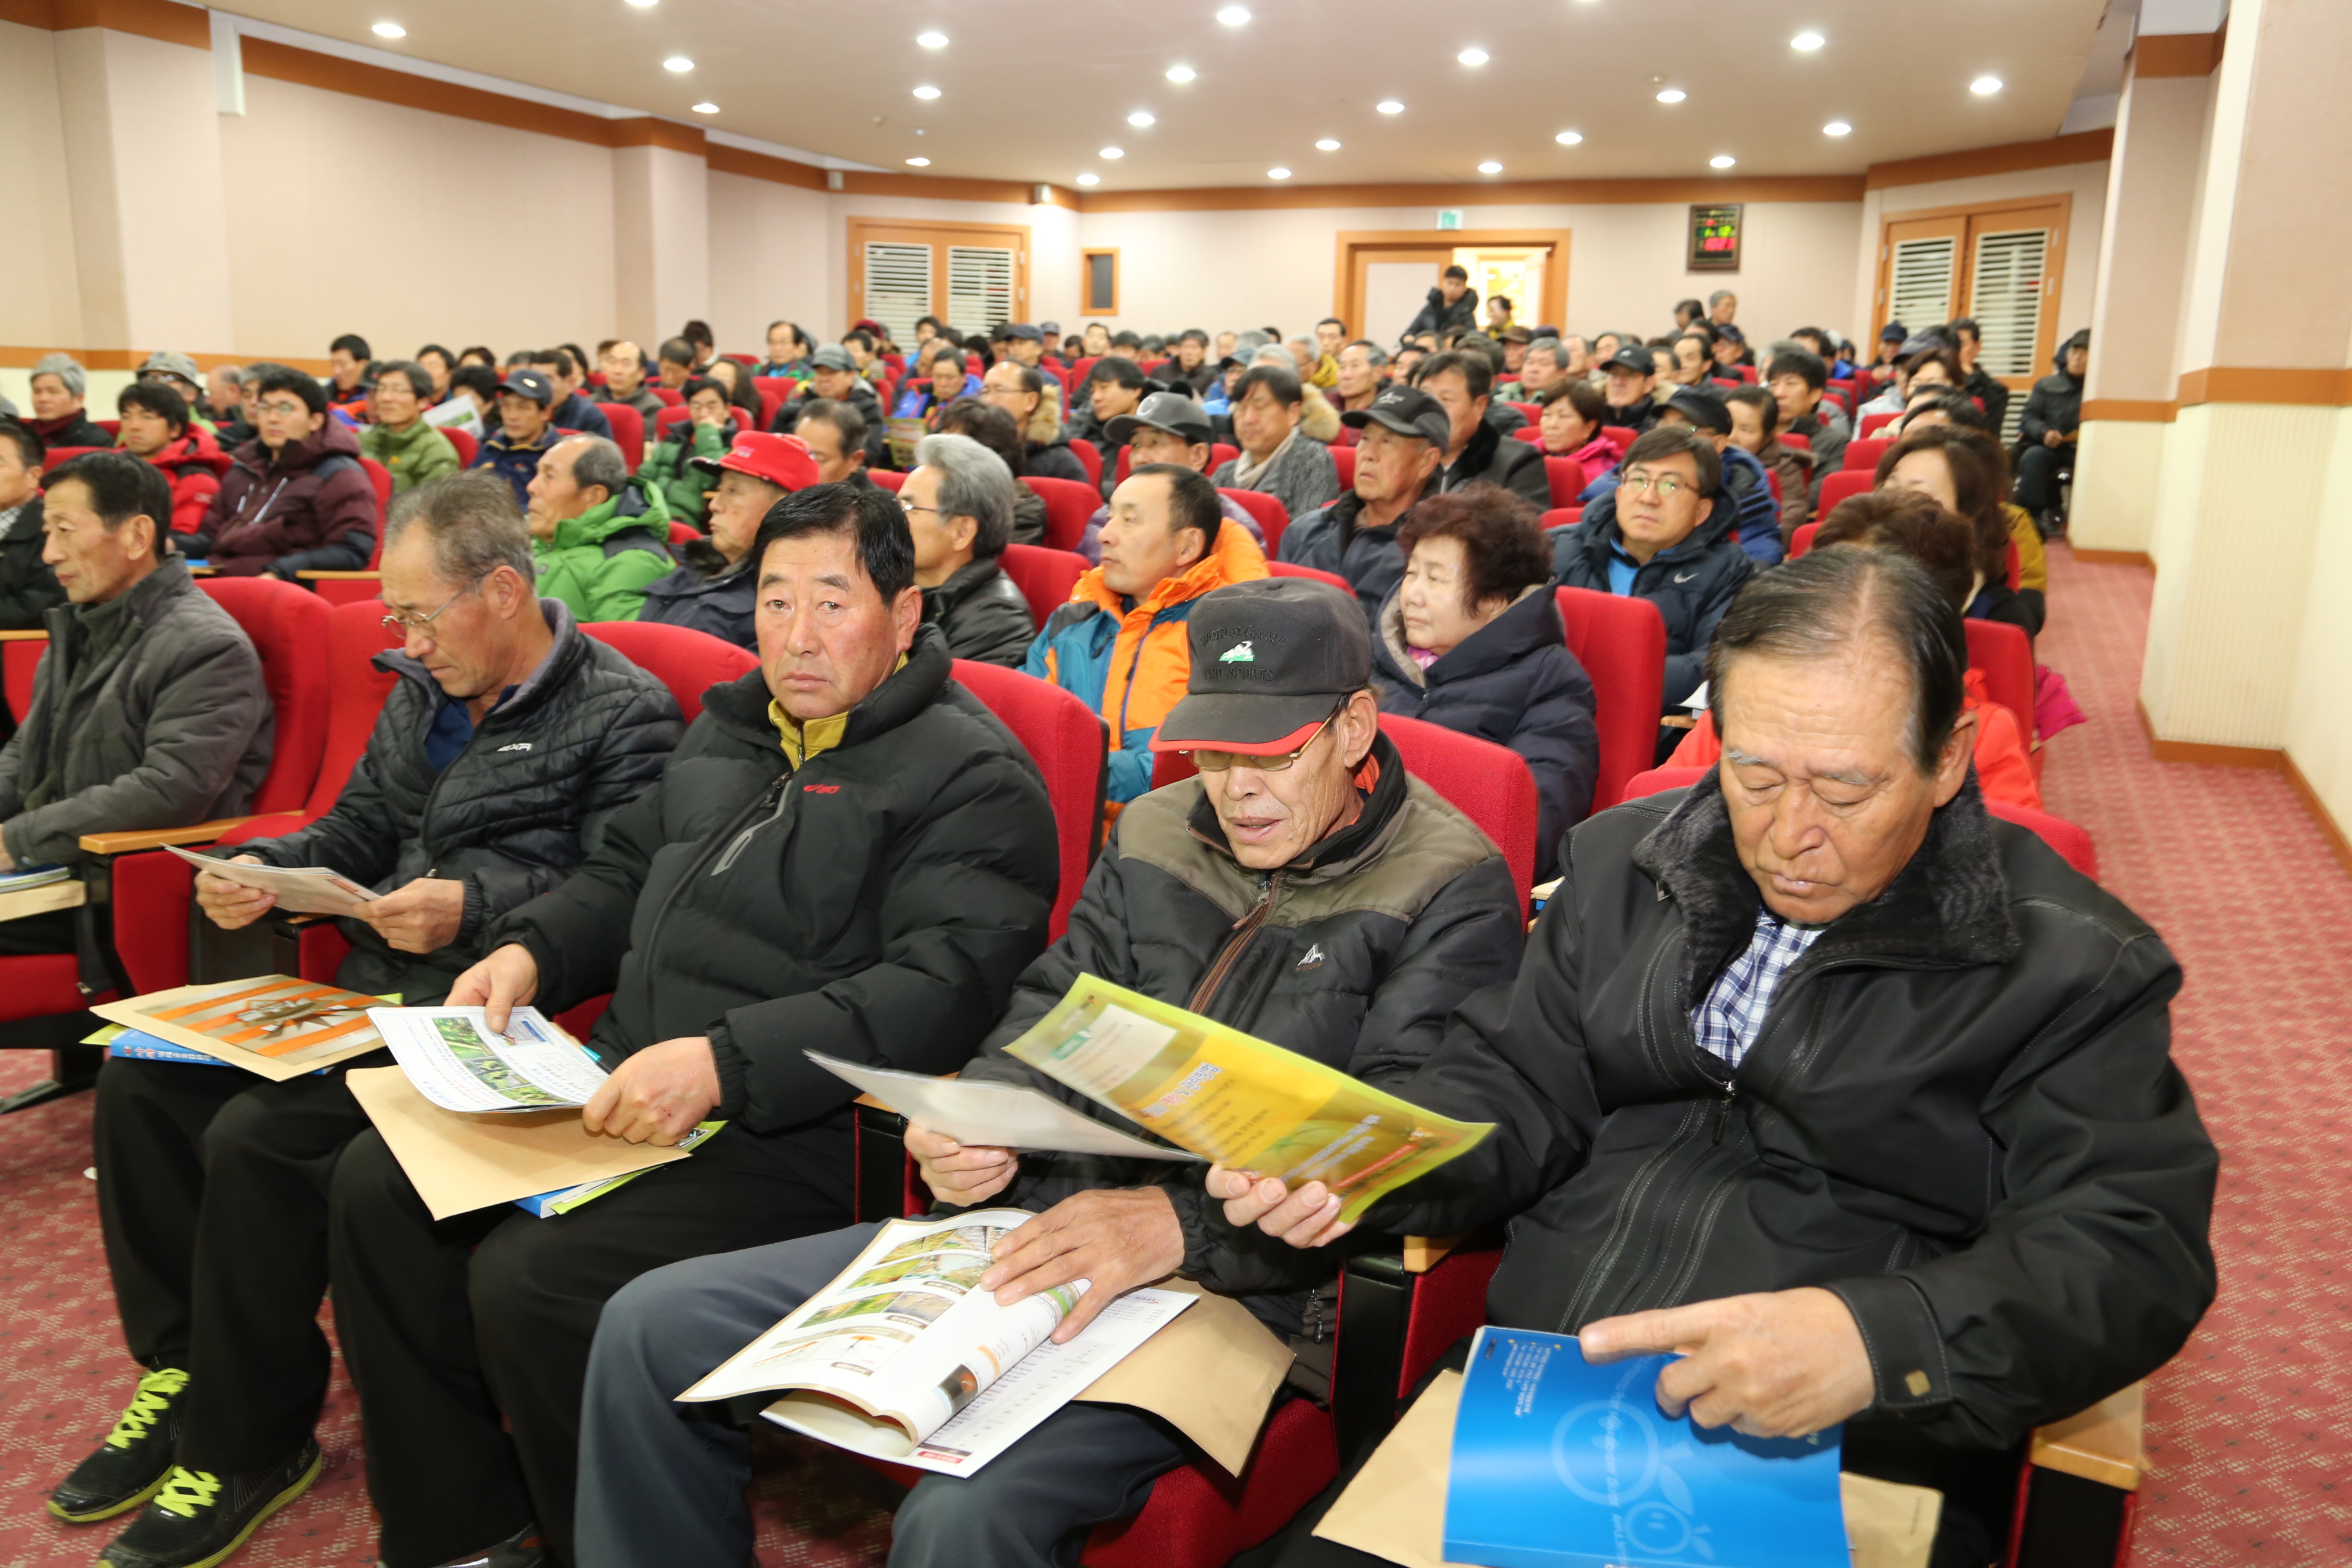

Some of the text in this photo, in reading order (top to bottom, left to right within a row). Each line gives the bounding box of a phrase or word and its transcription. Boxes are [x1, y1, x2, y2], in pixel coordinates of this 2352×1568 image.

[1200, 626, 1286, 649] WORLD GAME
[1205, 667, 1274, 681] PRO SPORTS
[1179, 1061, 1222, 1092] 관리방법
